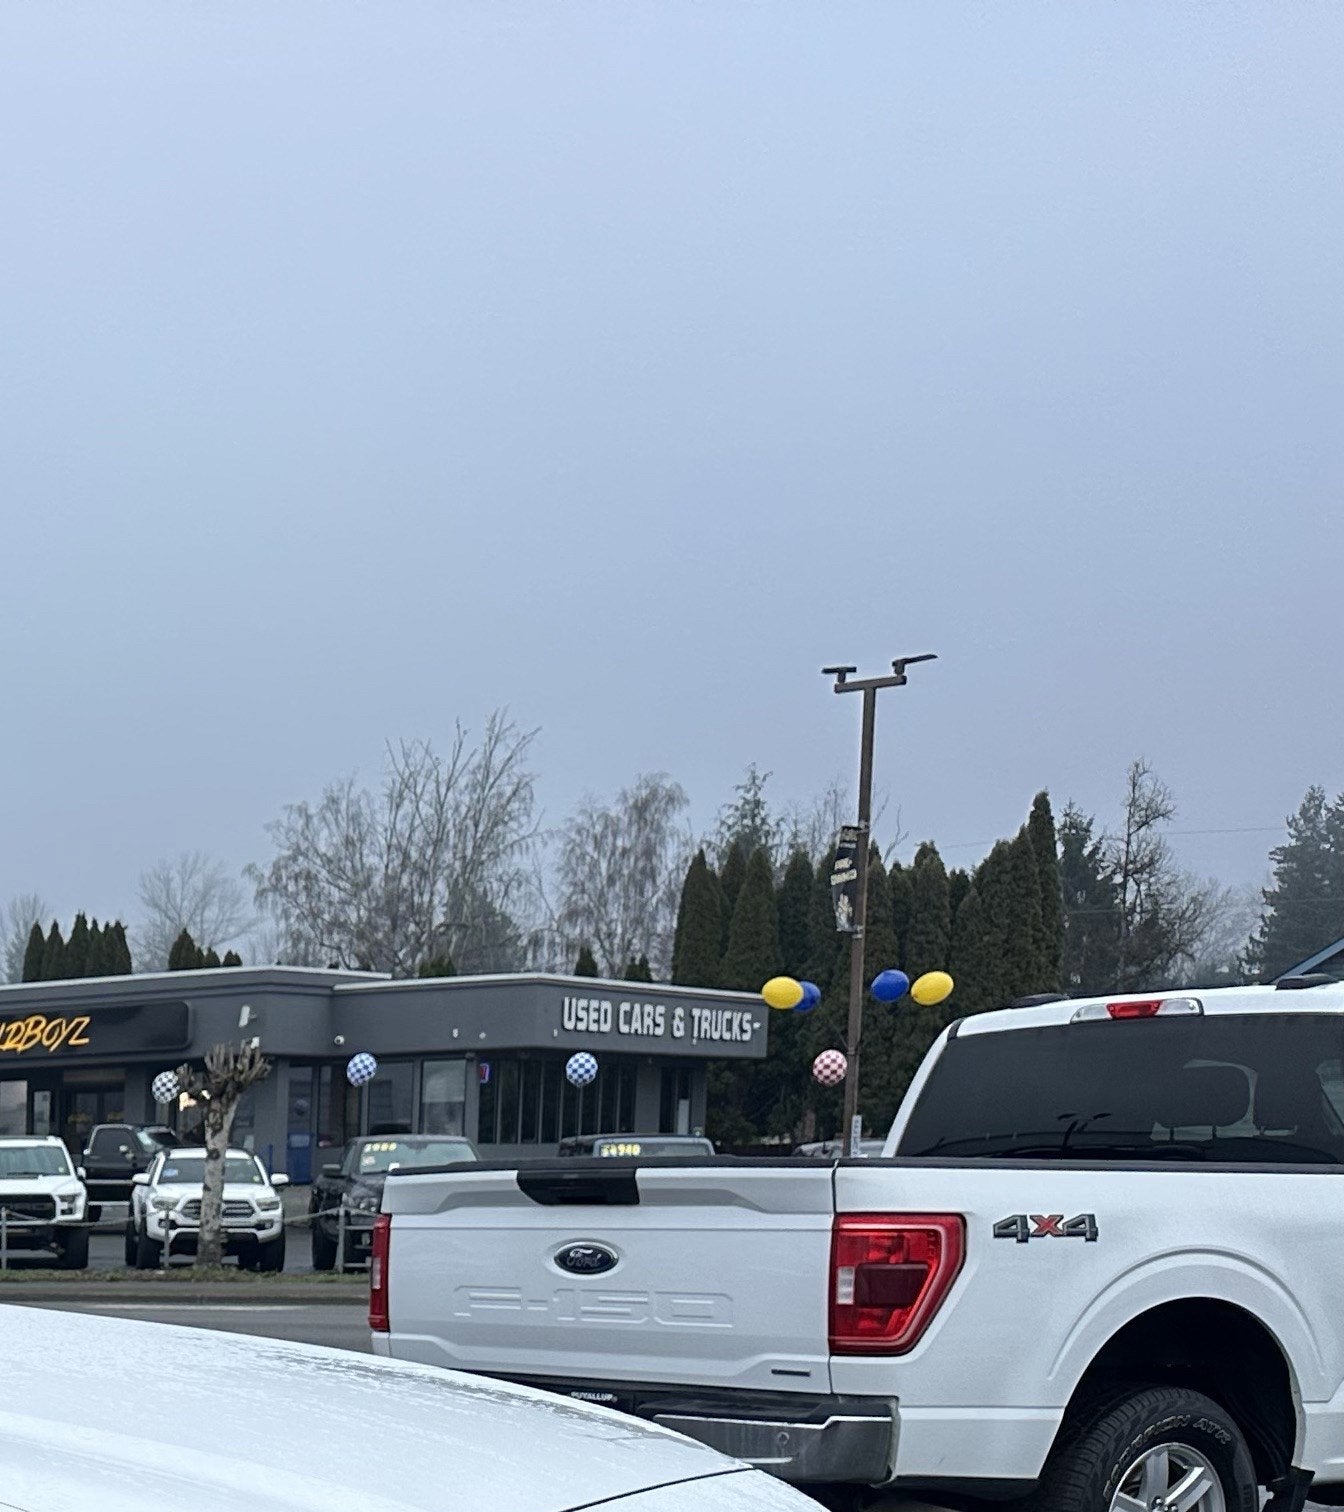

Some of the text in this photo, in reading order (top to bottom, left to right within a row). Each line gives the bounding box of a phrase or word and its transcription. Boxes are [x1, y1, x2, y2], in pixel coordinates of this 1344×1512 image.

[563, 997, 752, 1041] USED CARS & TRUCKS
[566, 1248, 602, 1267] Ford
[454, 1285, 733, 1328] F-150
